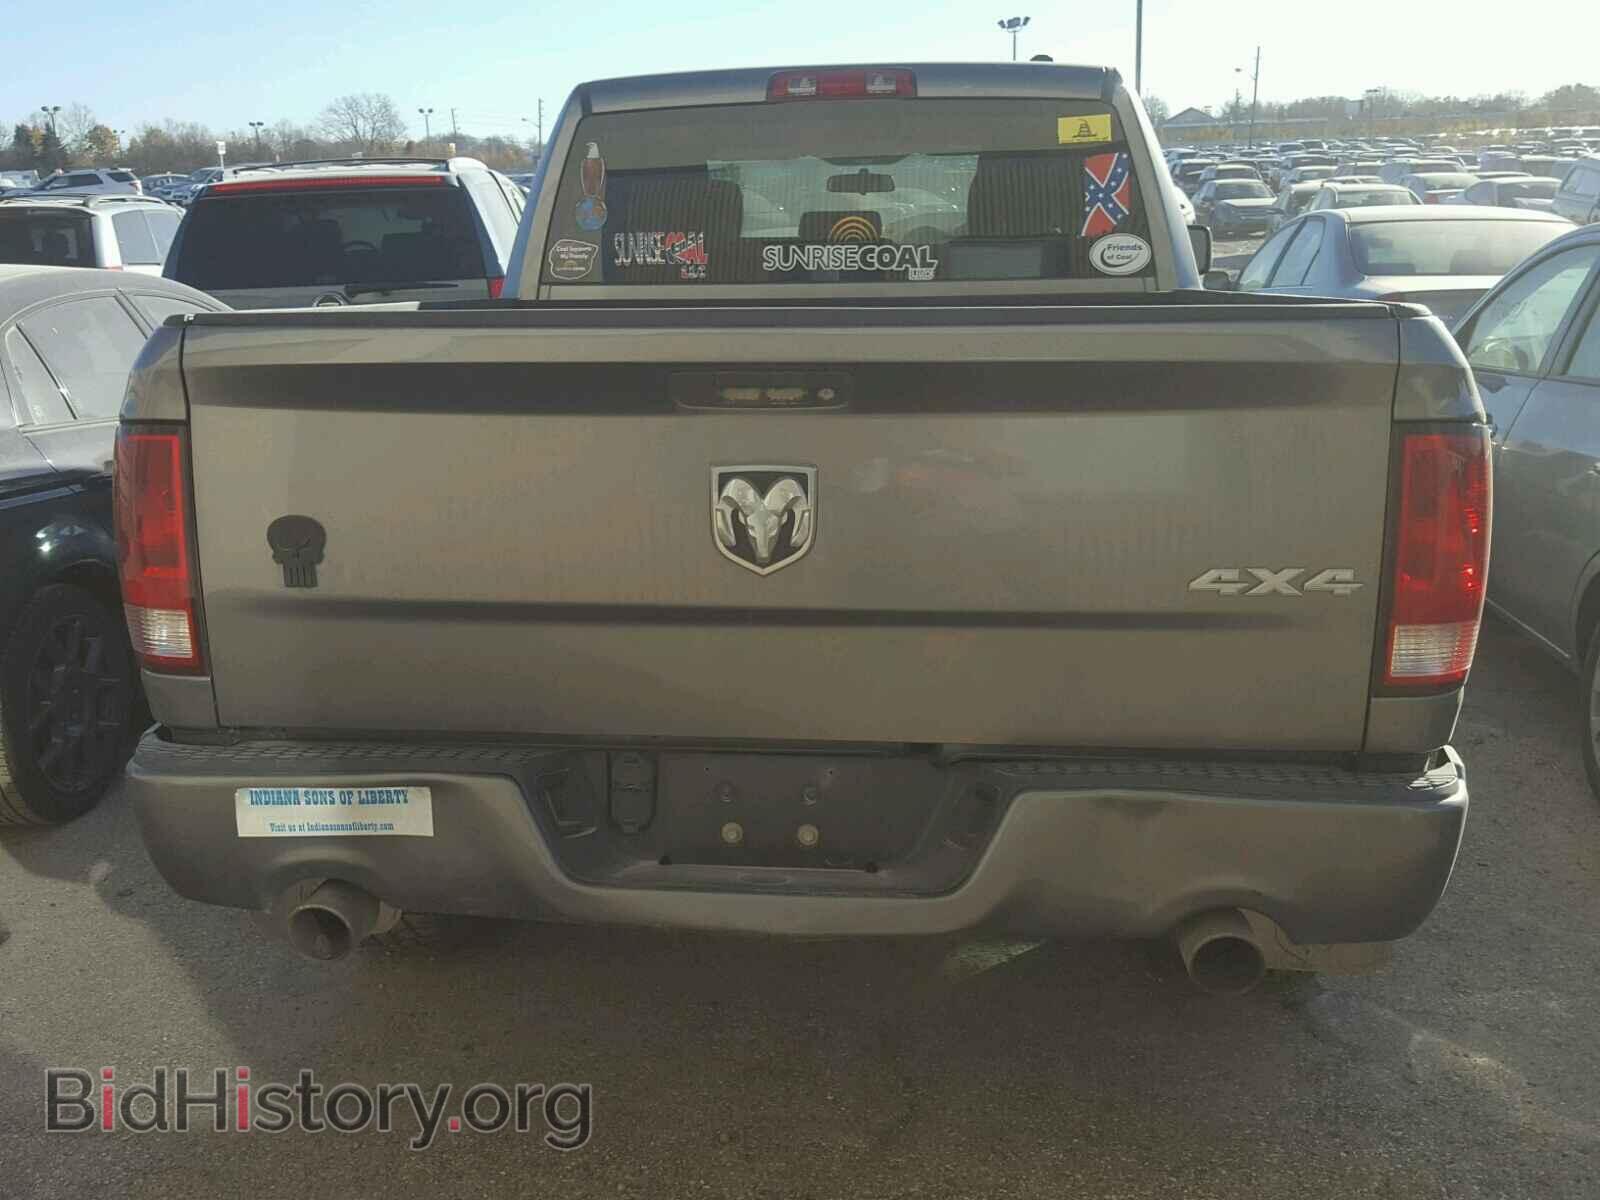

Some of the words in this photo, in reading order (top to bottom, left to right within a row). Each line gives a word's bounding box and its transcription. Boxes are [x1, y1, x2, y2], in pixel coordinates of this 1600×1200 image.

[1106, 243, 1143, 251] Friends
[250, 789, 301, 806] INDIANA
[303, 789, 336, 806] SONS
[339, 789, 354, 805] OF
[357, 789, 409, 805] LIBERTY
[270, 822, 287, 832] Visit
[288, 824, 297, 832] us
[298, 823, 306, 832] at
